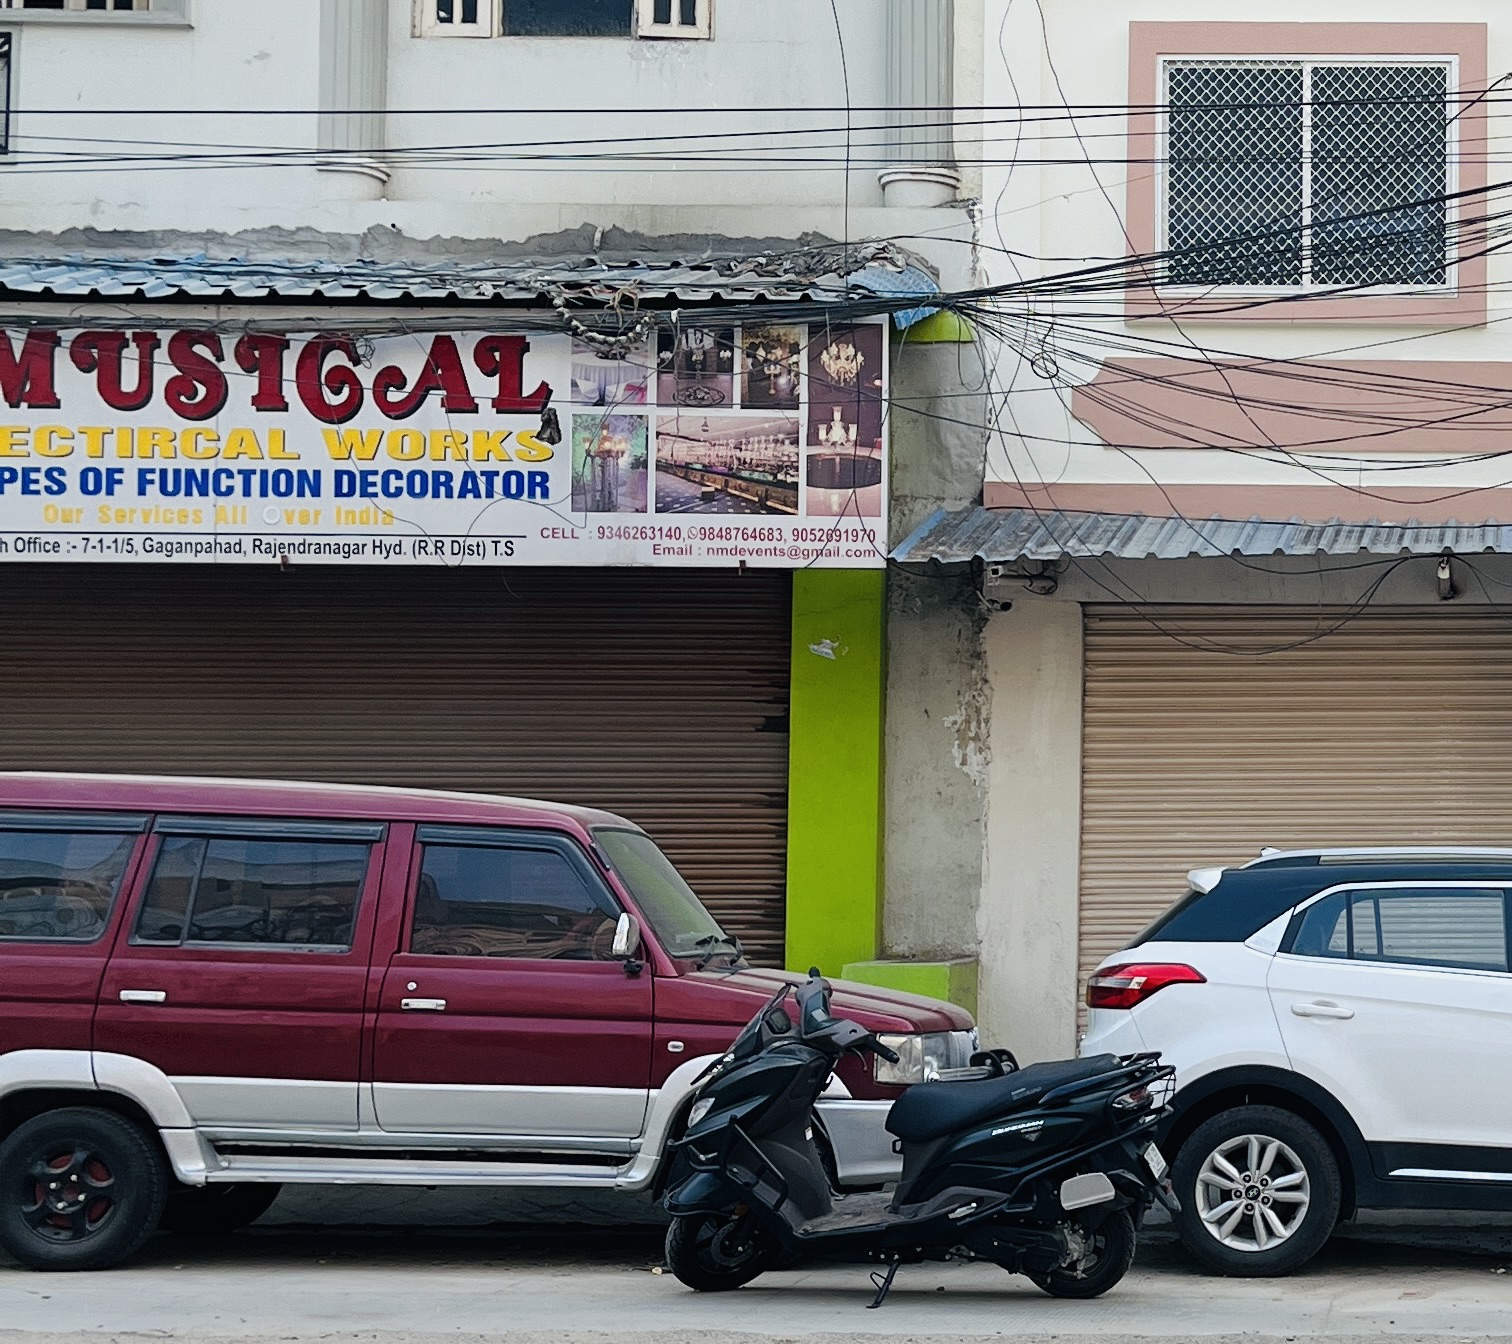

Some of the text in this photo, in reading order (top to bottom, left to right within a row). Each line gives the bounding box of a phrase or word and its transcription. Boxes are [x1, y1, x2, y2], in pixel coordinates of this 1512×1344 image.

[0, 328, 553, 425] MUSICAL
[0, 425, 555, 463] ECTIRCAL WORKS
[0, 466, 551, 500] PES OF FUNCTION DECORATOR
[43, 503, 84, 525] Our
[97, 504, 204, 525] Services
[215, 505, 248, 526] All
[334, 506, 395, 526] India
[540, 527, 580, 540] CELL
[13, 537, 61, 554] Office
[81, 537, 139, 557] 7-1-1/5,
[142, 537, 248, 558] Gaganpahad,
[252, 538, 367, 560] Rajendranagar
[371, 539, 408, 560] Hyd.
[450, 540, 487, 559] Dist)
[490, 540, 515, 558] T.S
[652, 543, 693, 557] Email
[706, 544, 877, 560] nmdevents@gmail.com
